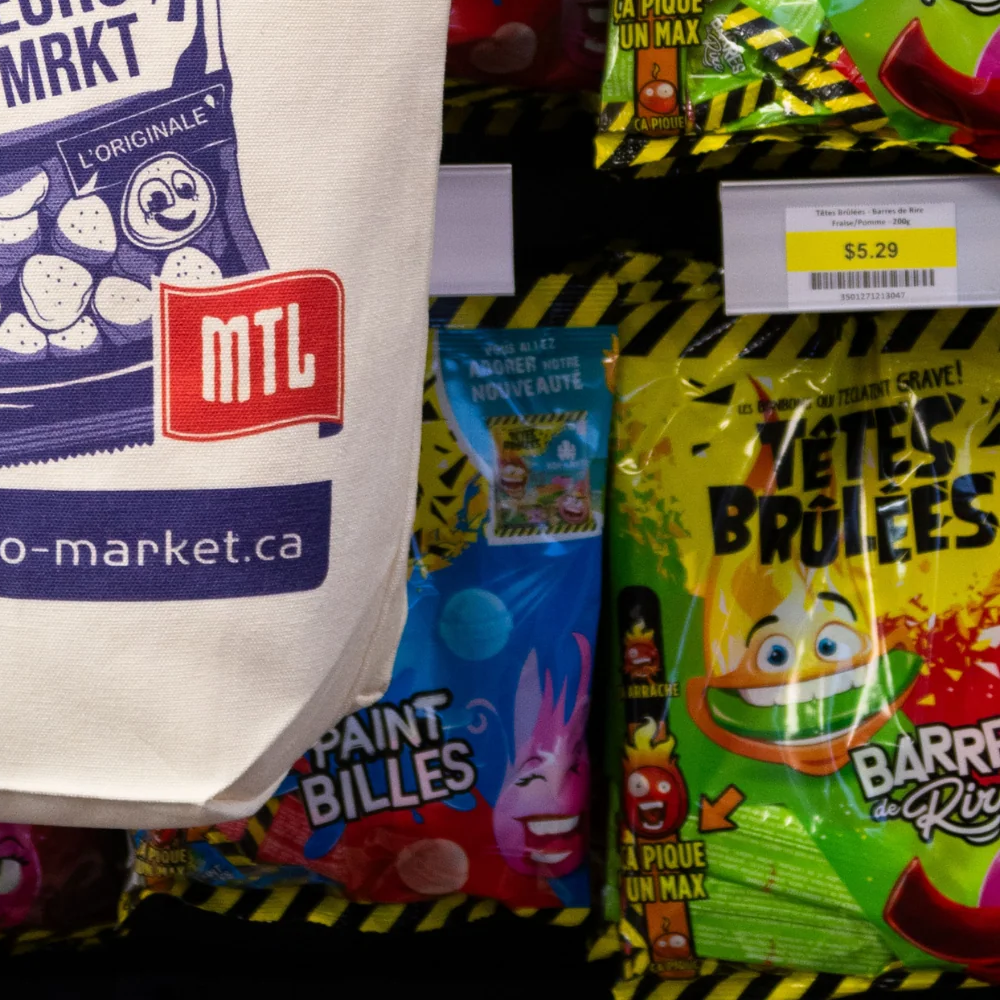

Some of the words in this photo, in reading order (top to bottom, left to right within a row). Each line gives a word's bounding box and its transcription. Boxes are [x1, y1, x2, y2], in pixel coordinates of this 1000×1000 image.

[620, 22, 652, 49] UN
[655, 18, 700, 47] MAX
[77, 106, 209, 169] L'ORIGINALE
[816, 208, 836, 217] Têtes
[872, 207, 896, 216] Barres
[909, 206, 924, 214] Rire
[832, 218, 886, 228] Fraise/Pomme
[892, 217, 911, 226] 200g
[844, 241, 899, 261] $5.29
[840, 291, 906, 301] 3501271213047
[201, 302, 316, 403] MTL
[519, 337, 556, 352] ALLEZ
[542, 355, 582, 371] NOTRE
[470, 371, 584, 402] NOUVEAUTÉ
[737, 403, 754, 415] LES
[896, 358, 963, 393] GRAVE!
[755, 393, 966, 493] TÊTES
[708, 471, 1000, 568] BRÛLÉES
[314, 693, 448, 769] PAINT
[302, 741, 476, 827] BILLES
[873, 798, 901, 818] de
[643, 841, 706, 869] PIQUE
[625, 875, 655, 902] UN
[660, 872, 707, 900] MAX
